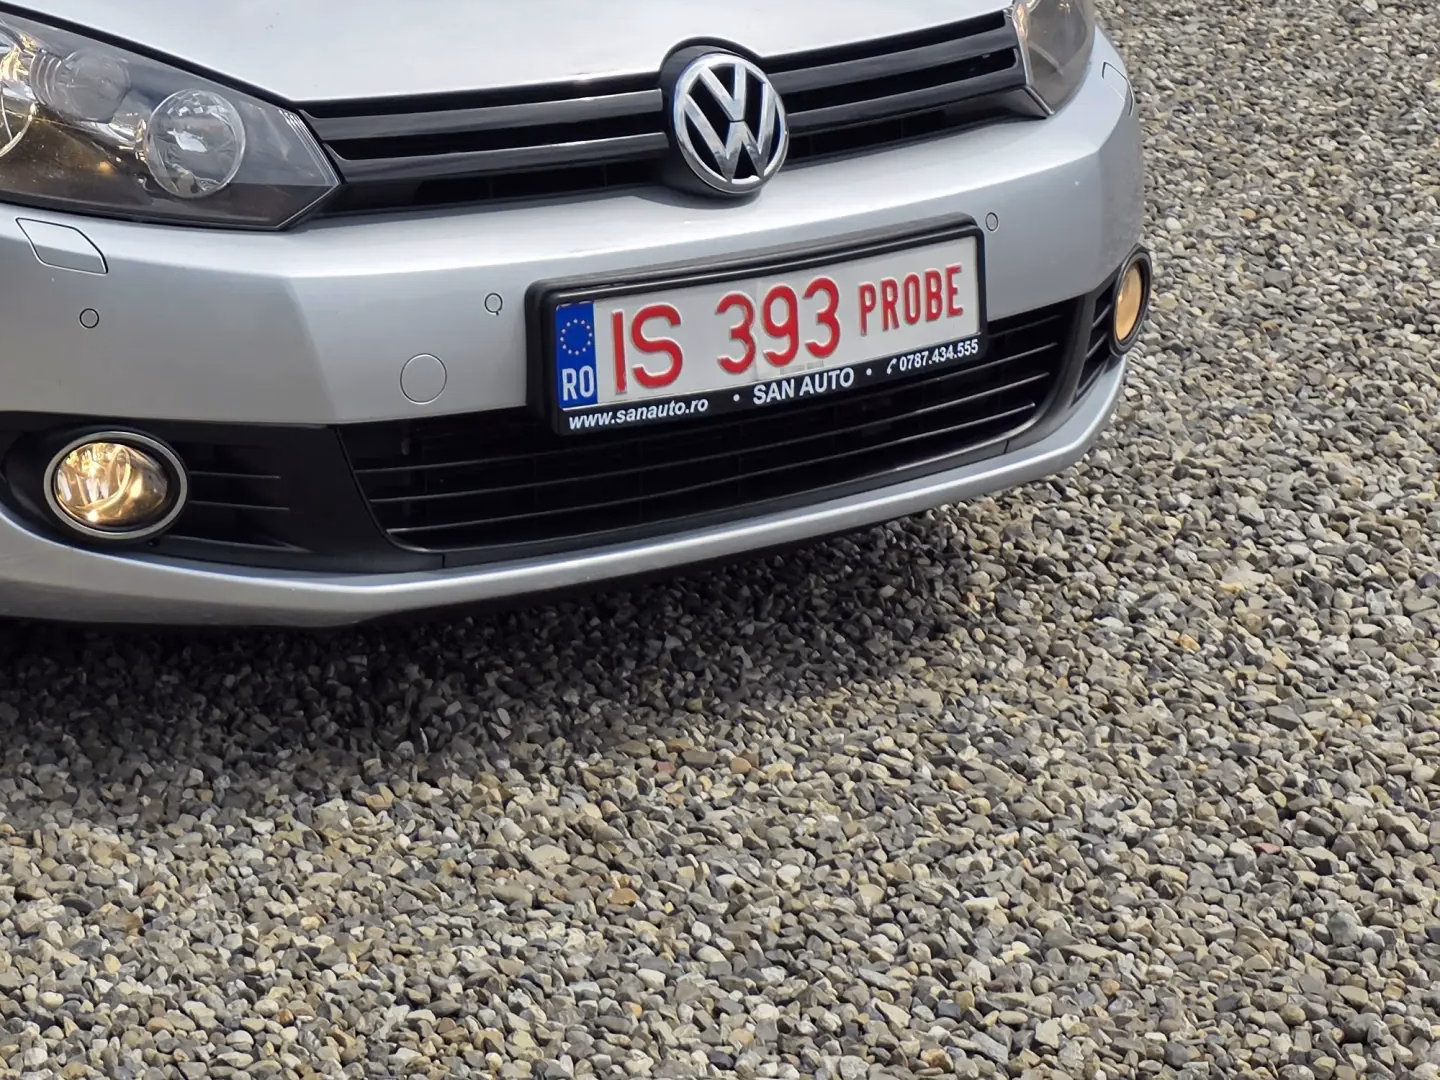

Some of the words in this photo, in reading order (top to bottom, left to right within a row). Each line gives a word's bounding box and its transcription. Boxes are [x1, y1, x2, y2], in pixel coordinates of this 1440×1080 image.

[610, 302, 683, 395] IS
[715, 276, 841, 375] 393
[858, 263, 964, 336] PROBE
[562, 365, 595, 401] RO
[569, 398, 708, 430] www.sanauto.ro
[753, 378, 794, 405] SAN
[799, 368, 854, 396] AUTO
[900, 338, 978, 371] 0787.434.555
